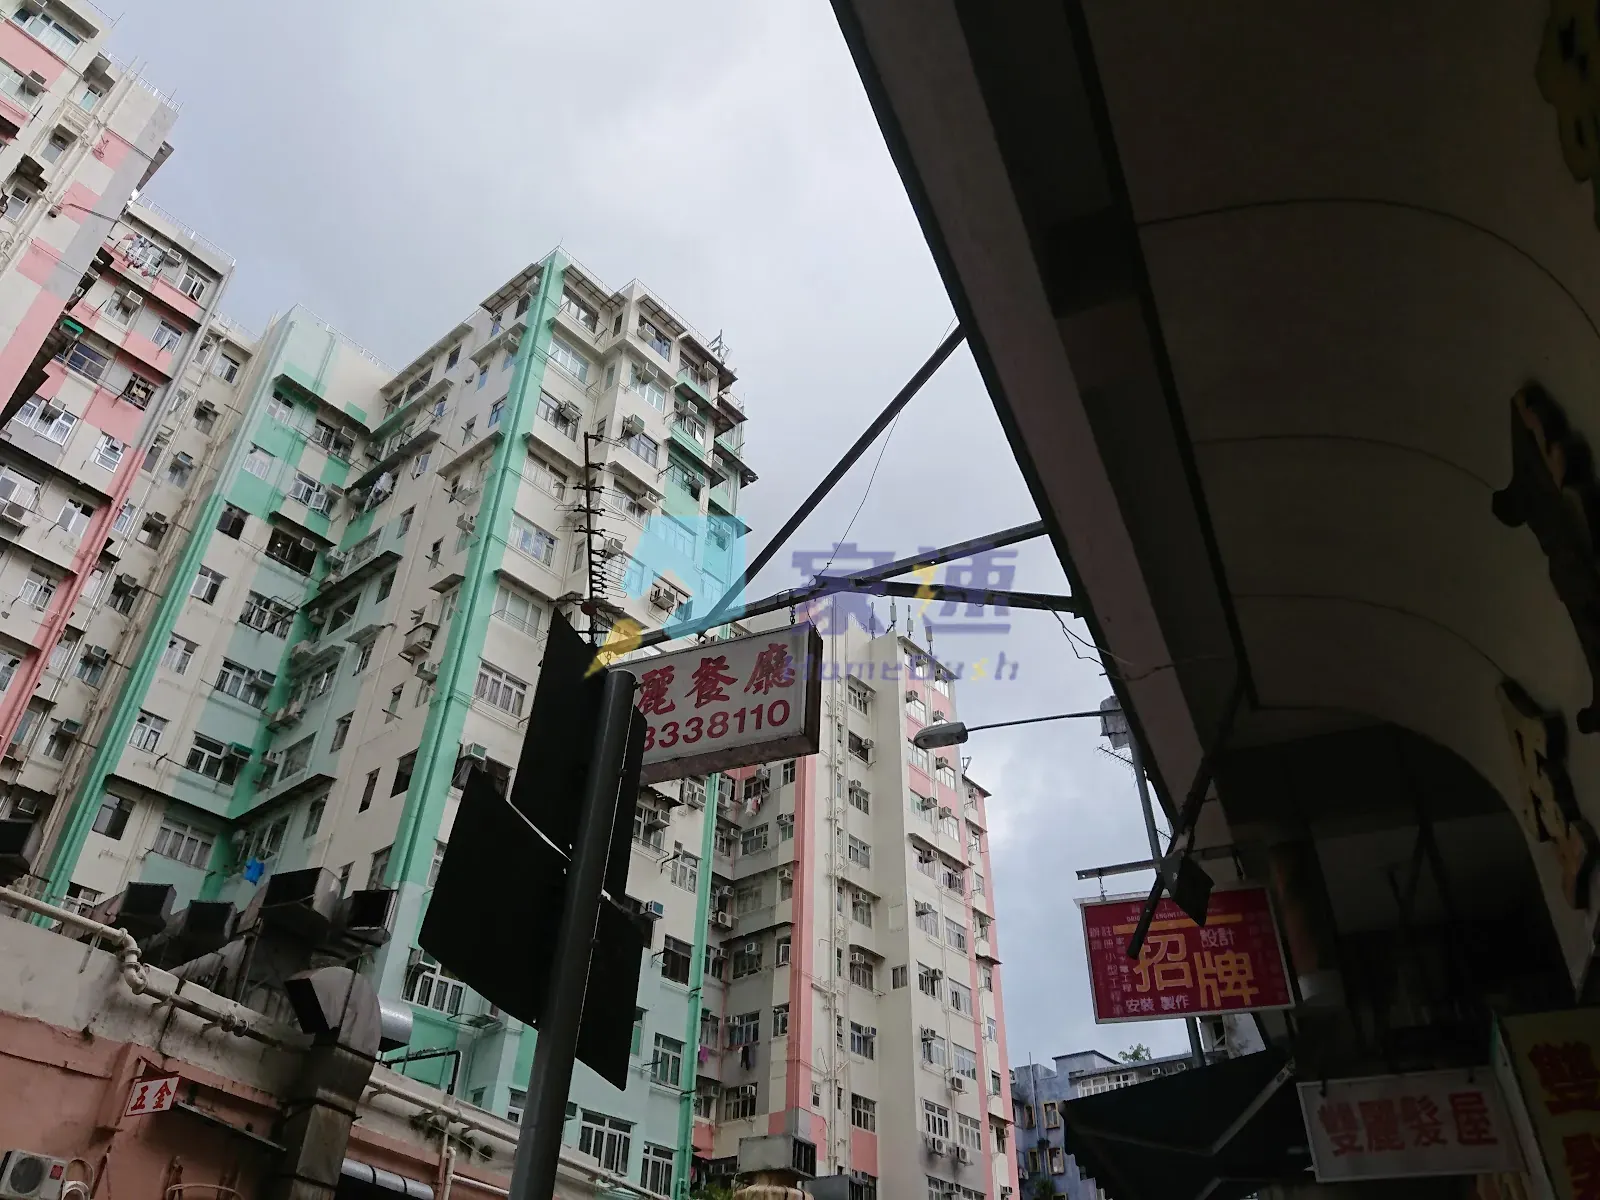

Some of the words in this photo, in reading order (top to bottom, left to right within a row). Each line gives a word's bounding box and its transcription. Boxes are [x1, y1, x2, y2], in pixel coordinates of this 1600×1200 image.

[637, 643, 796, 716] 麗餐廳
[1200, 927, 1236, 949] 設計
[1133, 933, 1260, 1009] 招牌
[1125, 997, 1156, 1014] 安裝
[1160, 994, 1190, 1011] 製作
[131, 1081, 172, 1111] 五金
